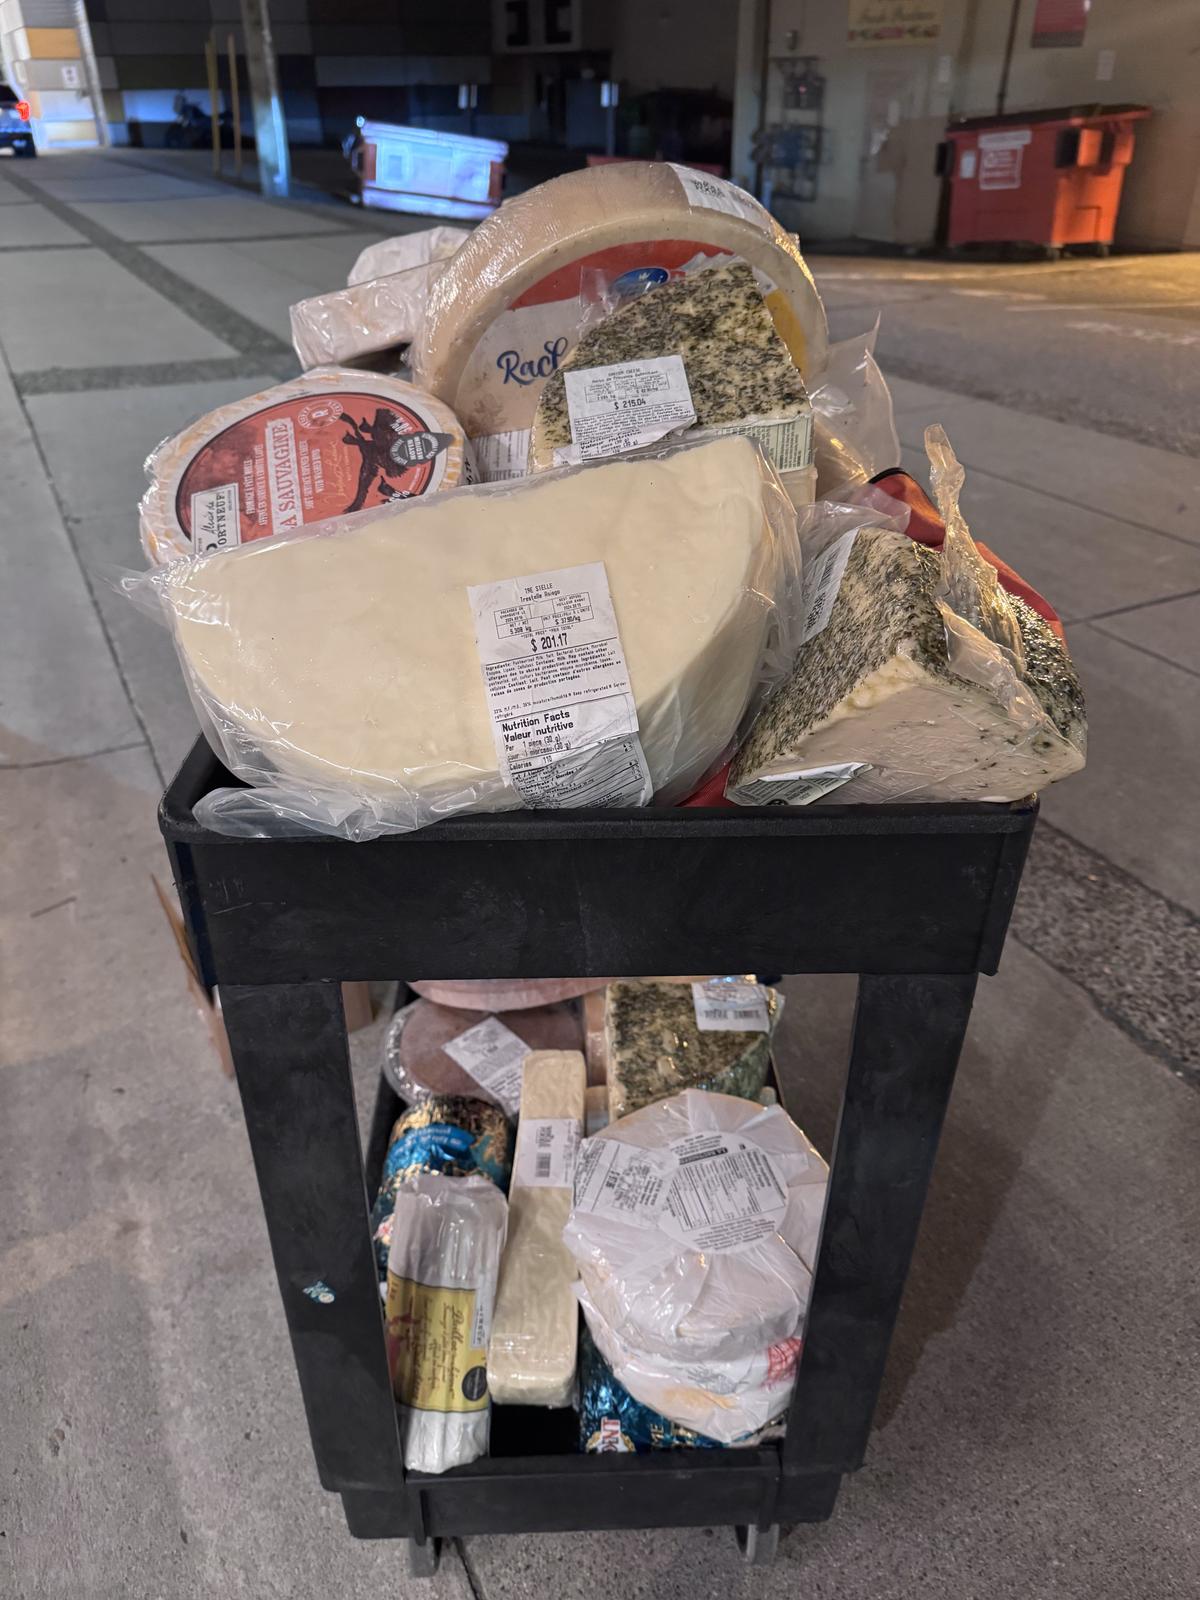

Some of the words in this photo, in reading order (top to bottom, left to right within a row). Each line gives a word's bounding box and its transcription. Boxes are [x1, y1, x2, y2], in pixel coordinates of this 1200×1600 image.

[623, 398, 646, 408] 215.04
[407, 439, 416, 460] MOYEN
[413, 436, 423, 460] MEDIUM
[270, 422, 295, 511] SAUVAGINE
[280, 514, 298, 530] A
[535, 583, 553, 591] STELLE
[531, 639, 537, 652] $
[541, 633, 567, 650] 201.17
[534, 680, 557, 688] production
[502, 718, 540, 732] Nutrition
[544, 710, 570, 723] Facts
[504, 732, 531, 743] Valeur
[536, 722, 573, 736] nutritive
[509, 761, 532, 771] Calories
[543, 755, 552, 763] 110
